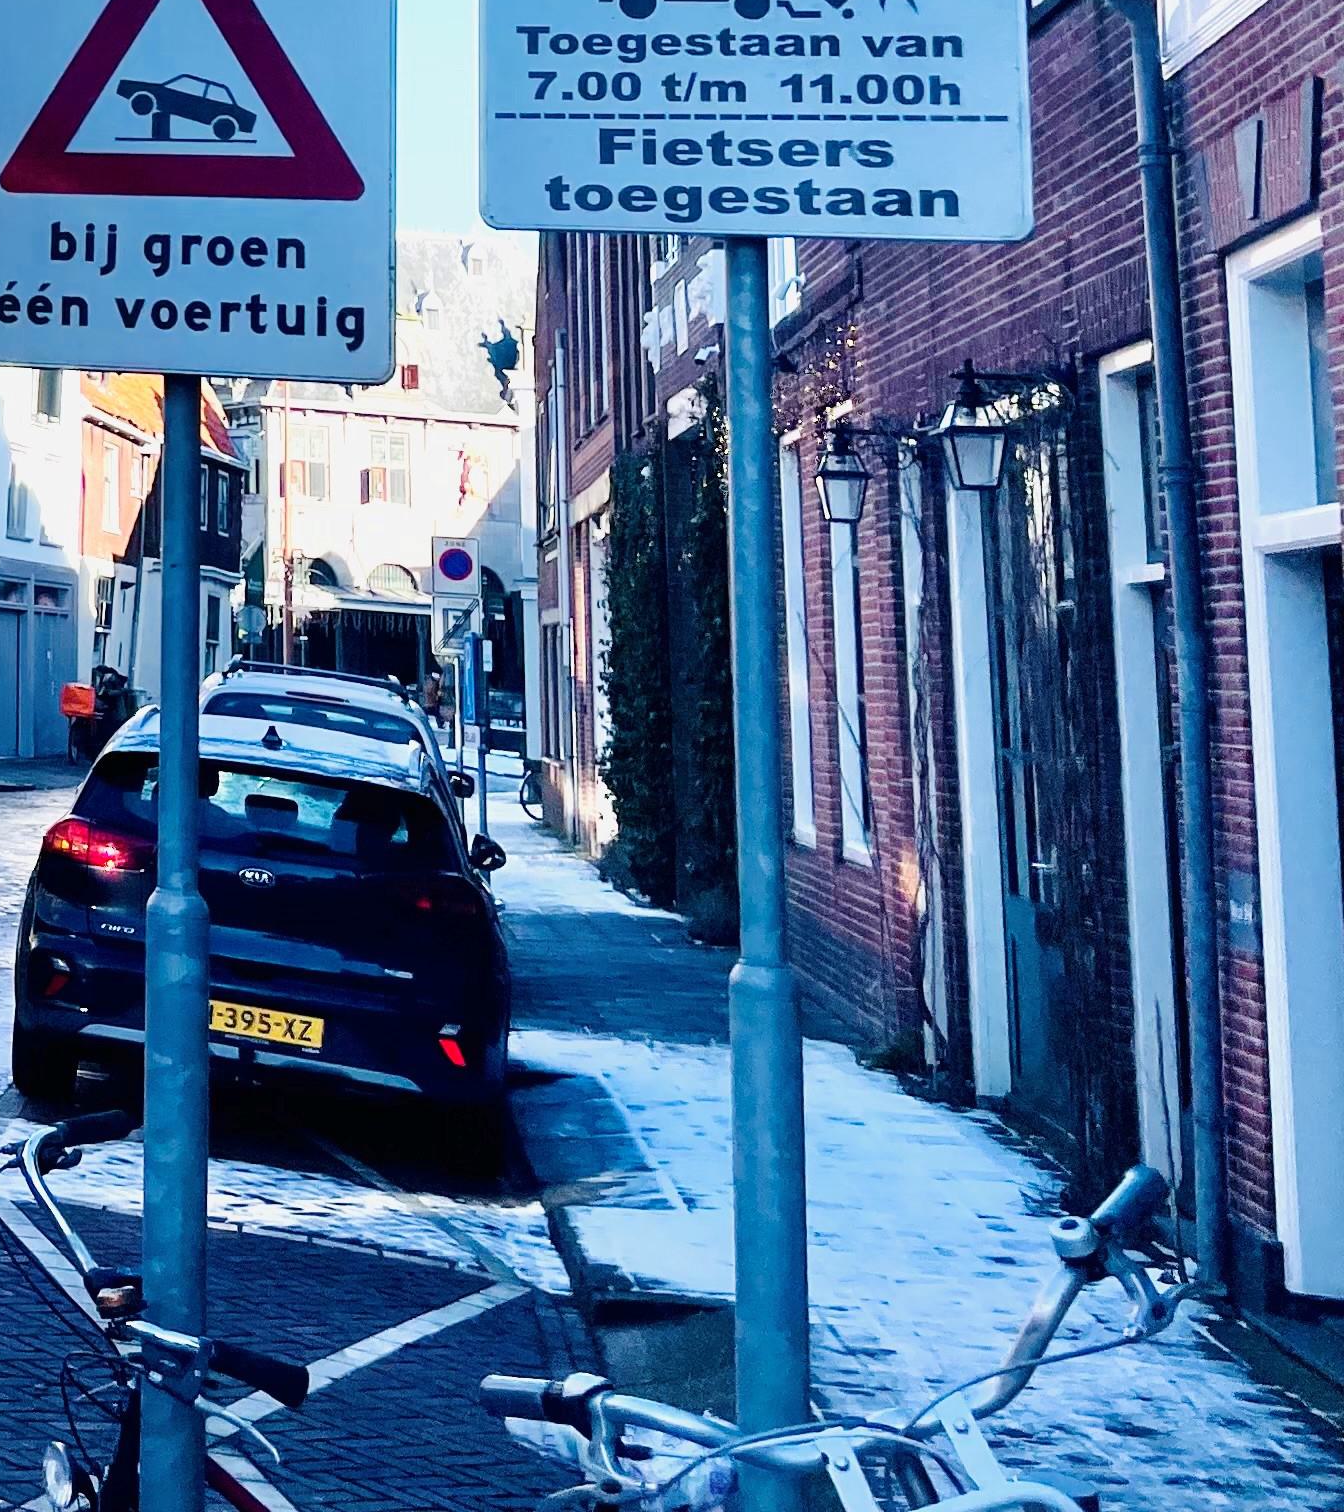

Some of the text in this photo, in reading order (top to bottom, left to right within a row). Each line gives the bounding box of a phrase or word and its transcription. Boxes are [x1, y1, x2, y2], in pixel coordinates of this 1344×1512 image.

[515, 25, 964, 64] Toegestaan van
[527, 71, 962, 106] 7.00 t/m 11.00h
[598, 127, 895, 169] Fietsers
[544, 175, 961, 224] toegestaan
[50, 221, 306, 278] bij groen
[114, 293, 366, 353] voertuig
